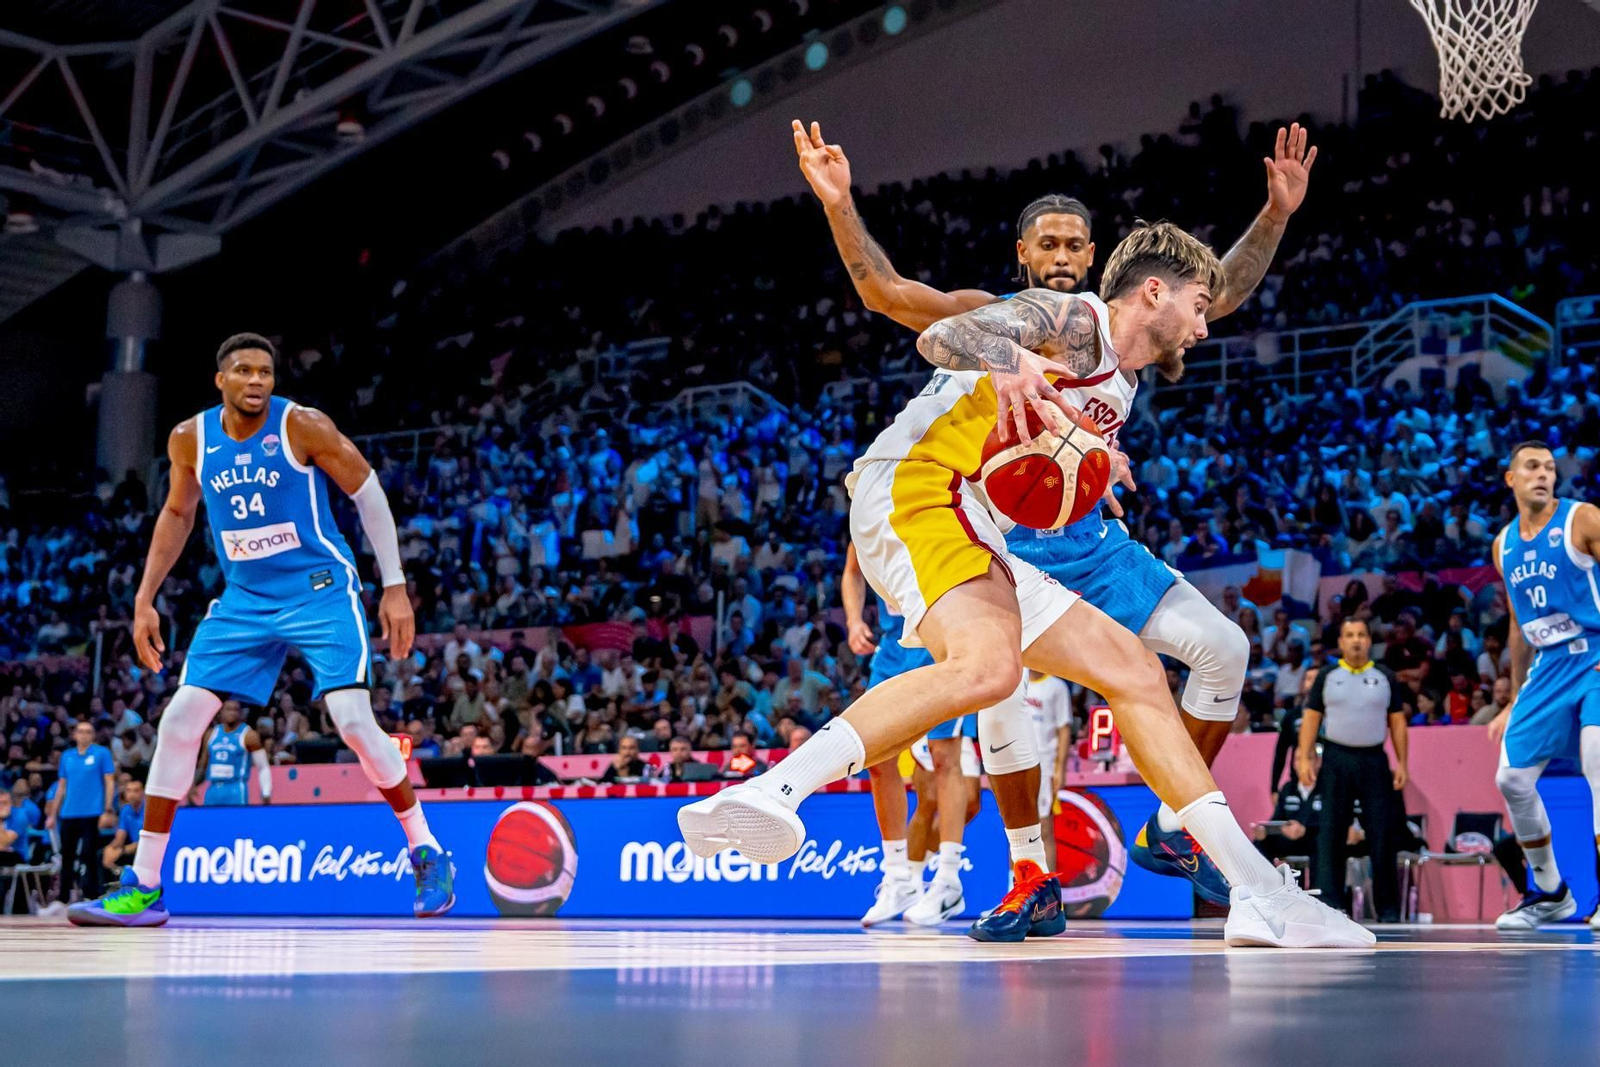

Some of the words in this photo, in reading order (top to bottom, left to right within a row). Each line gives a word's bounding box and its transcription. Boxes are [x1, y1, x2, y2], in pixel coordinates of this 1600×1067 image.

[210, 465, 280, 493] HELLAS
[230, 492, 266, 520] 34
[247, 532, 296, 551] onan
[1509, 561, 1557, 588] HELLAS
[1525, 585, 1547, 608] 10
[173, 838, 302, 884] molten
[307, 845, 354, 882] feel
[349, 850, 383, 878] the
[787, 839, 843, 880] feel
[838, 845, 880, 877] the
